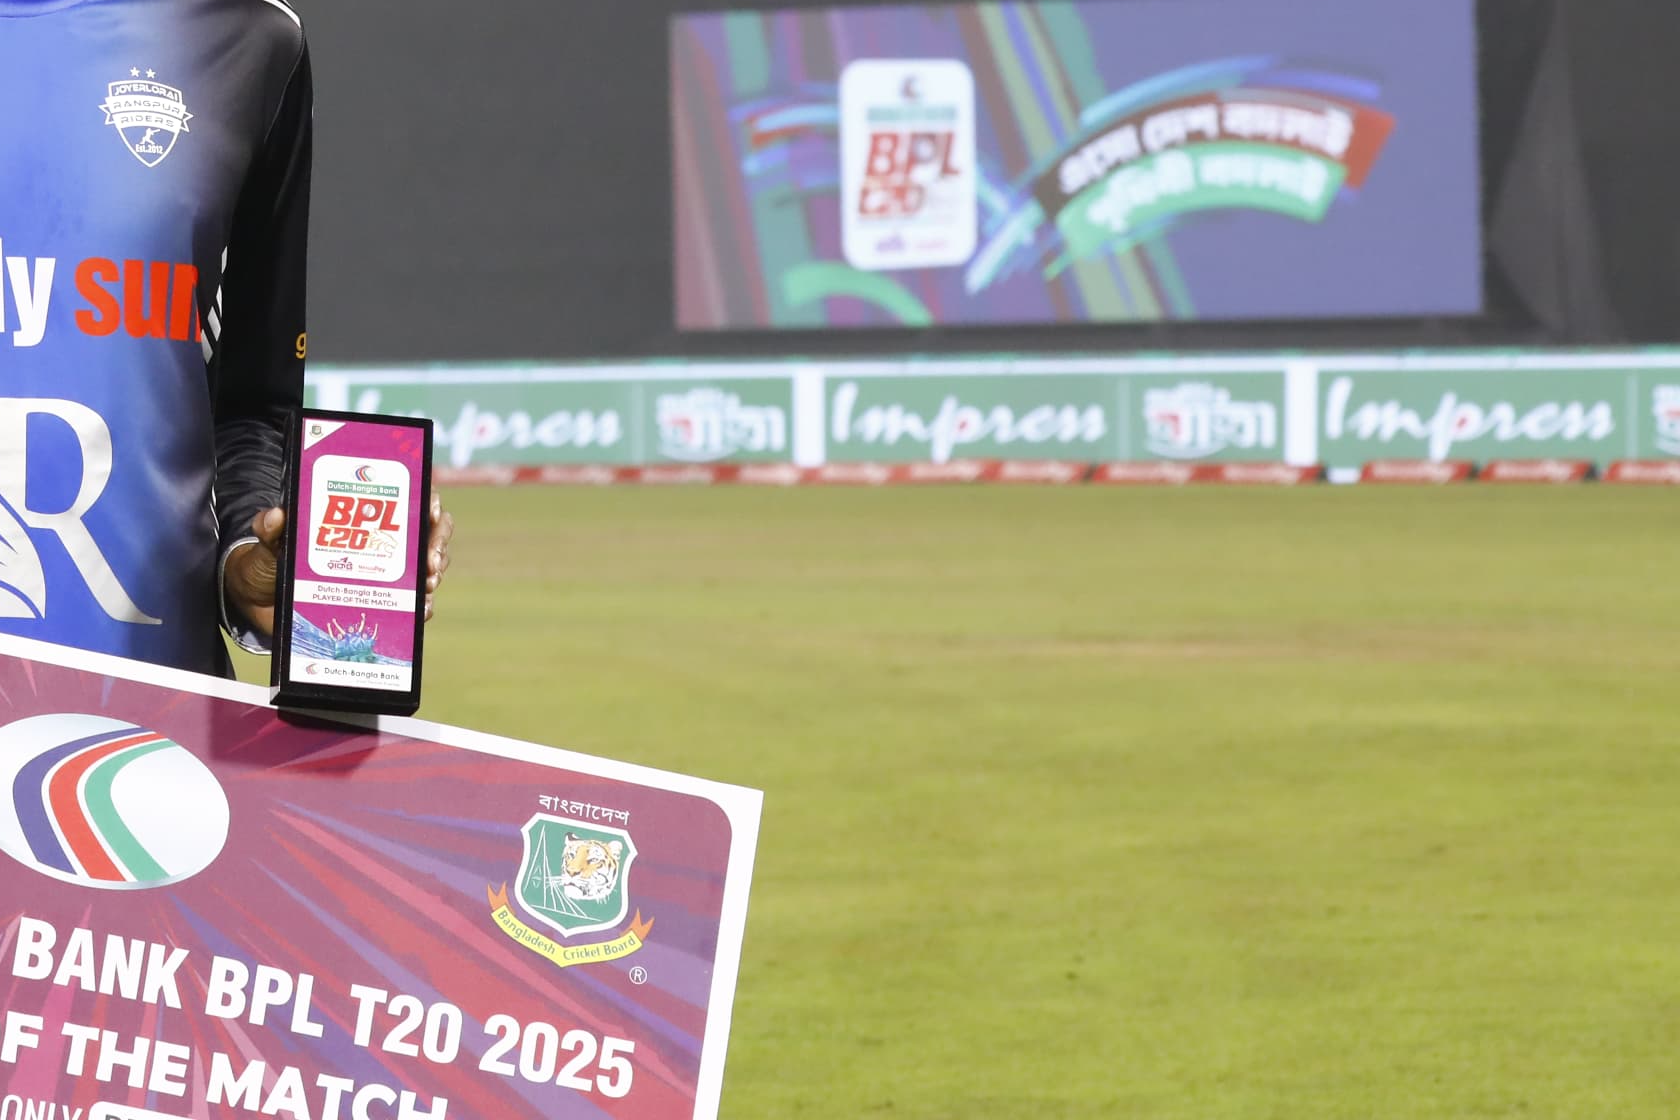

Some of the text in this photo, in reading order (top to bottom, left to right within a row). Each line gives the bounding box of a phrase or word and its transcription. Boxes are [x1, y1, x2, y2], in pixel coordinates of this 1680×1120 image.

[113, 99, 181, 115] RANGPUR
[114, 82, 180, 102] JOYERLORAI
[120, 114, 175, 128] RIDERS
[865, 131, 962, 180] BPL
[831, 381, 1108, 466] Impress
[1325, 376, 1616, 463] Impress
[327, 481, 399, 495] Dutch-Bangla Bank
[322, 494, 400, 532] BPL
[312, 593, 342, 602] PLAYER
[355, 597, 370, 605] THE
[371, 599, 398, 607] MATCH
[317, 585, 392, 598] Dutch-Bangla Bank
[324, 667, 400, 680] Dutch-Bangla Bank
[538, 794, 631, 826] বাংলাদেশ
[497, 909, 637, 961] Bangladesh Cricket Board
[11, 915, 190, 1010] BANK
[204, 955, 325, 1038] BPL
[348, 983, 464, 1065] T20
[478, 1012, 637, 1099] 2025
[61, 1022, 191, 1098] THE
